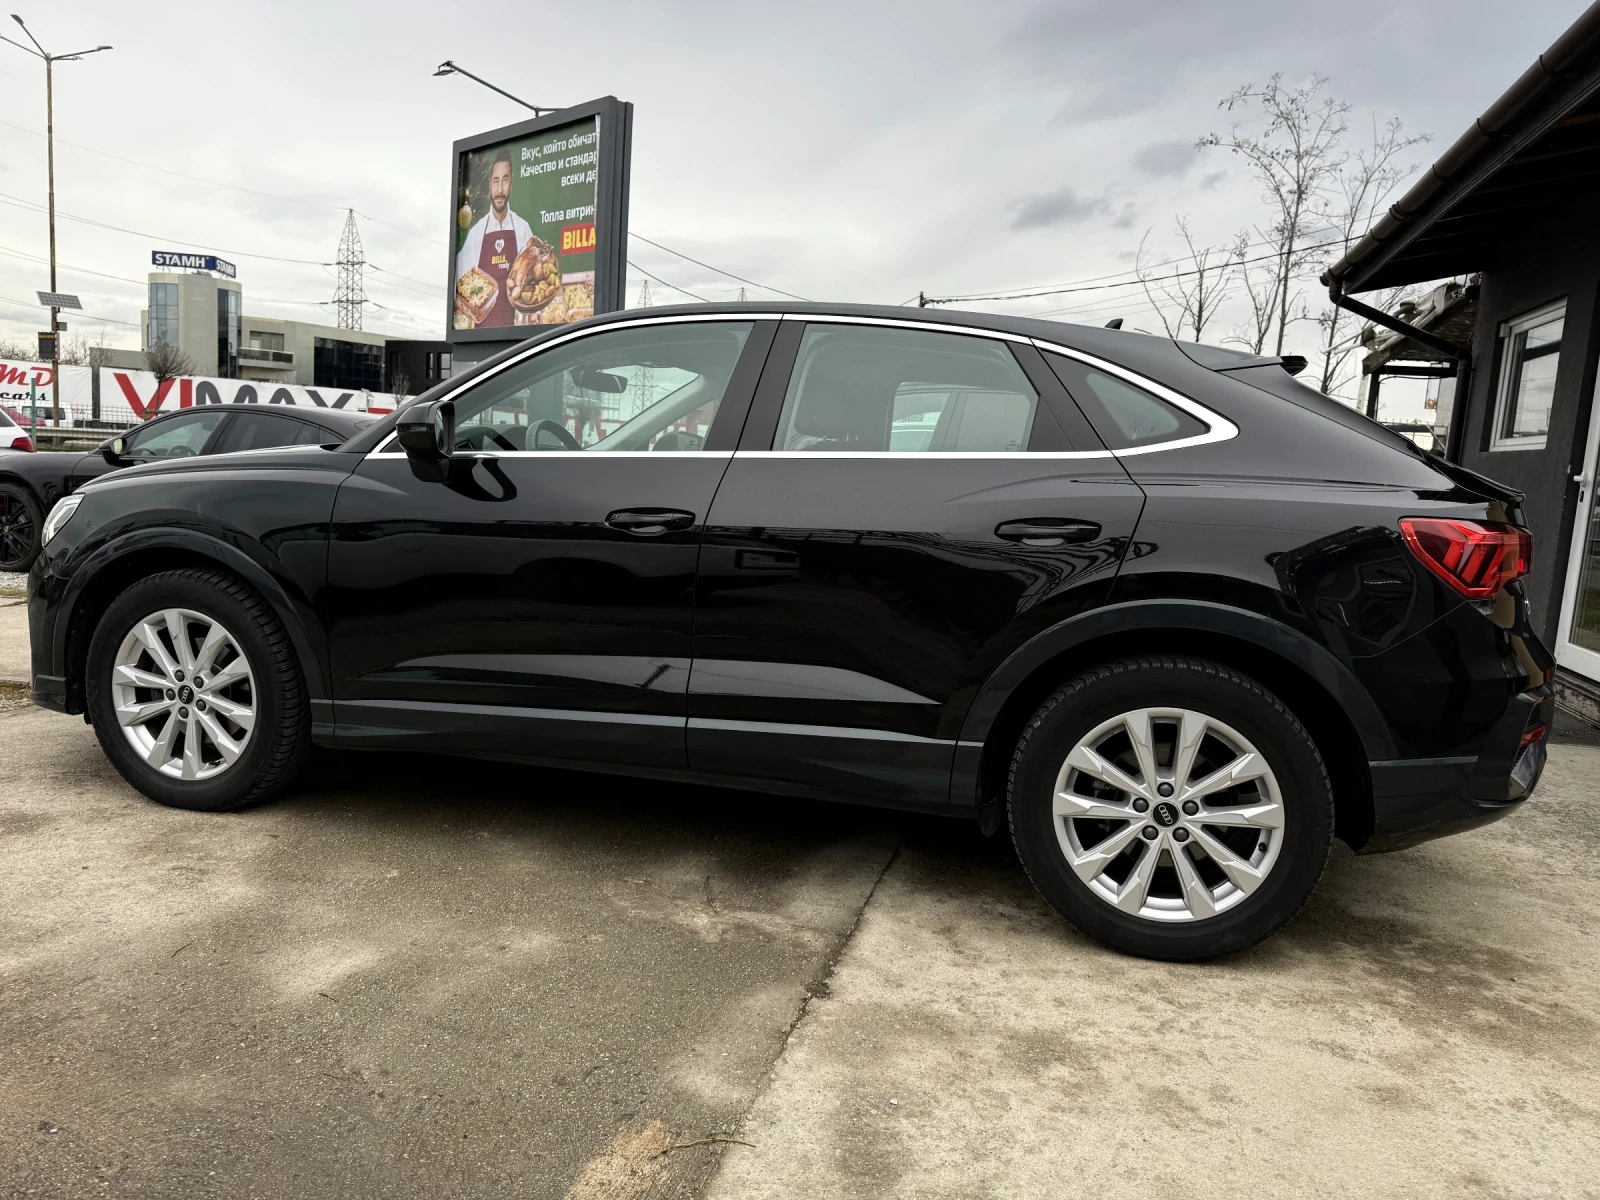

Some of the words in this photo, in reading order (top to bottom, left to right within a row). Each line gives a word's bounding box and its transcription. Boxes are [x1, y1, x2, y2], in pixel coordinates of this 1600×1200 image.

[521, 147, 541, 161] Вкус,
[543, 139, 567, 155] който
[520, 164, 557, 178] Качество
[558, 158, 564, 170] и
[561, 172, 585, 187] всеки
[540, 210, 564, 224] Топла
[563, 227, 596, 250] BILLA
[155, 253, 206, 268] STAMH
